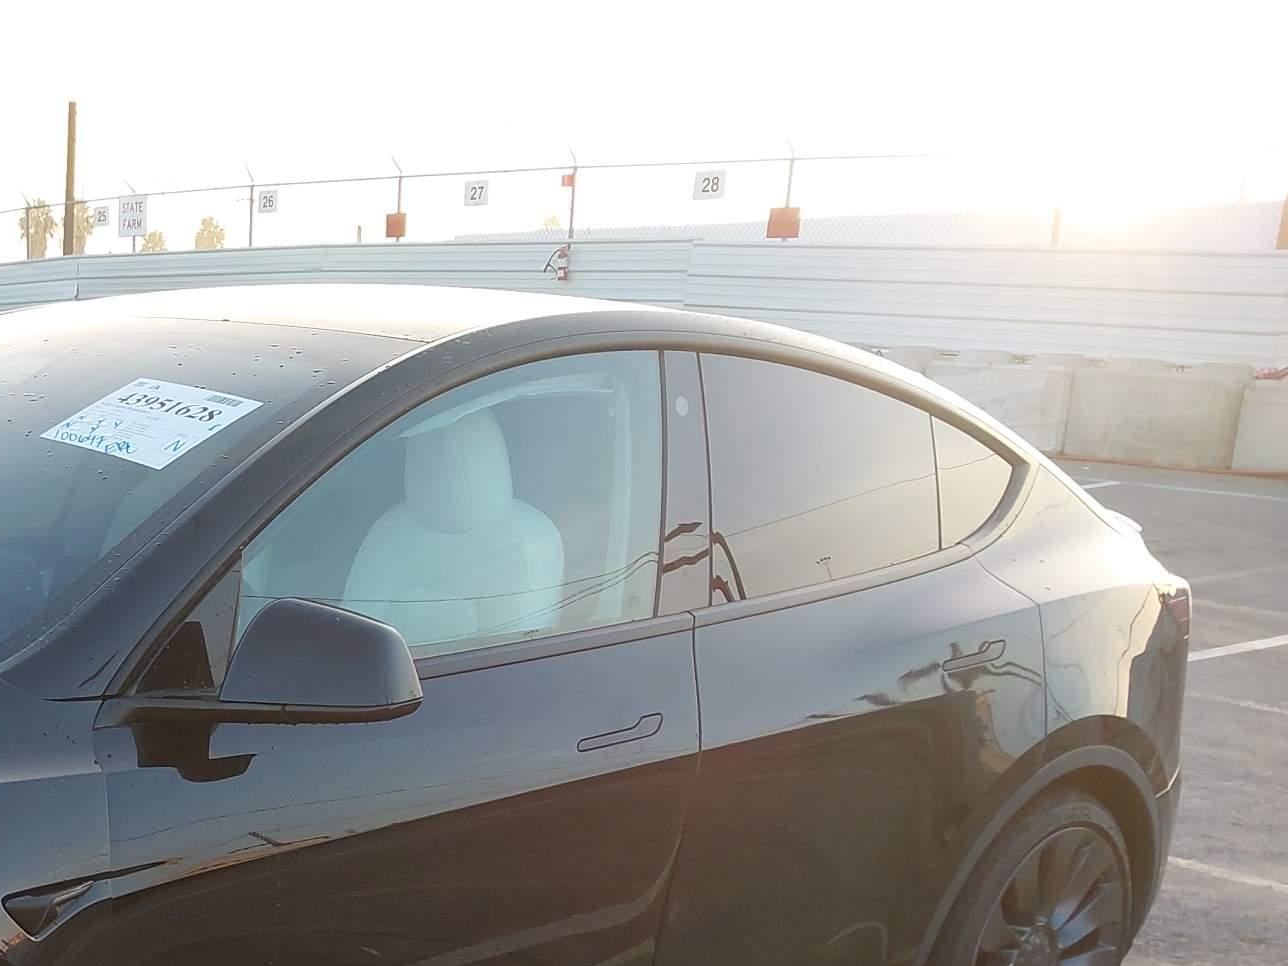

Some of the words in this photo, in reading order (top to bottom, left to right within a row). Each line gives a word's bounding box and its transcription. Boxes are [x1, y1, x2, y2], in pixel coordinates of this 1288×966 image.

[701, 176, 721, 193] 28
[470, 186, 485, 201] 27
[122, 201, 143, 214] STATE
[262, 195, 274, 208] 26
[97, 211, 107, 222] 25
[122, 218, 142, 230] FARM
[118, 392, 223, 423] 43951628
